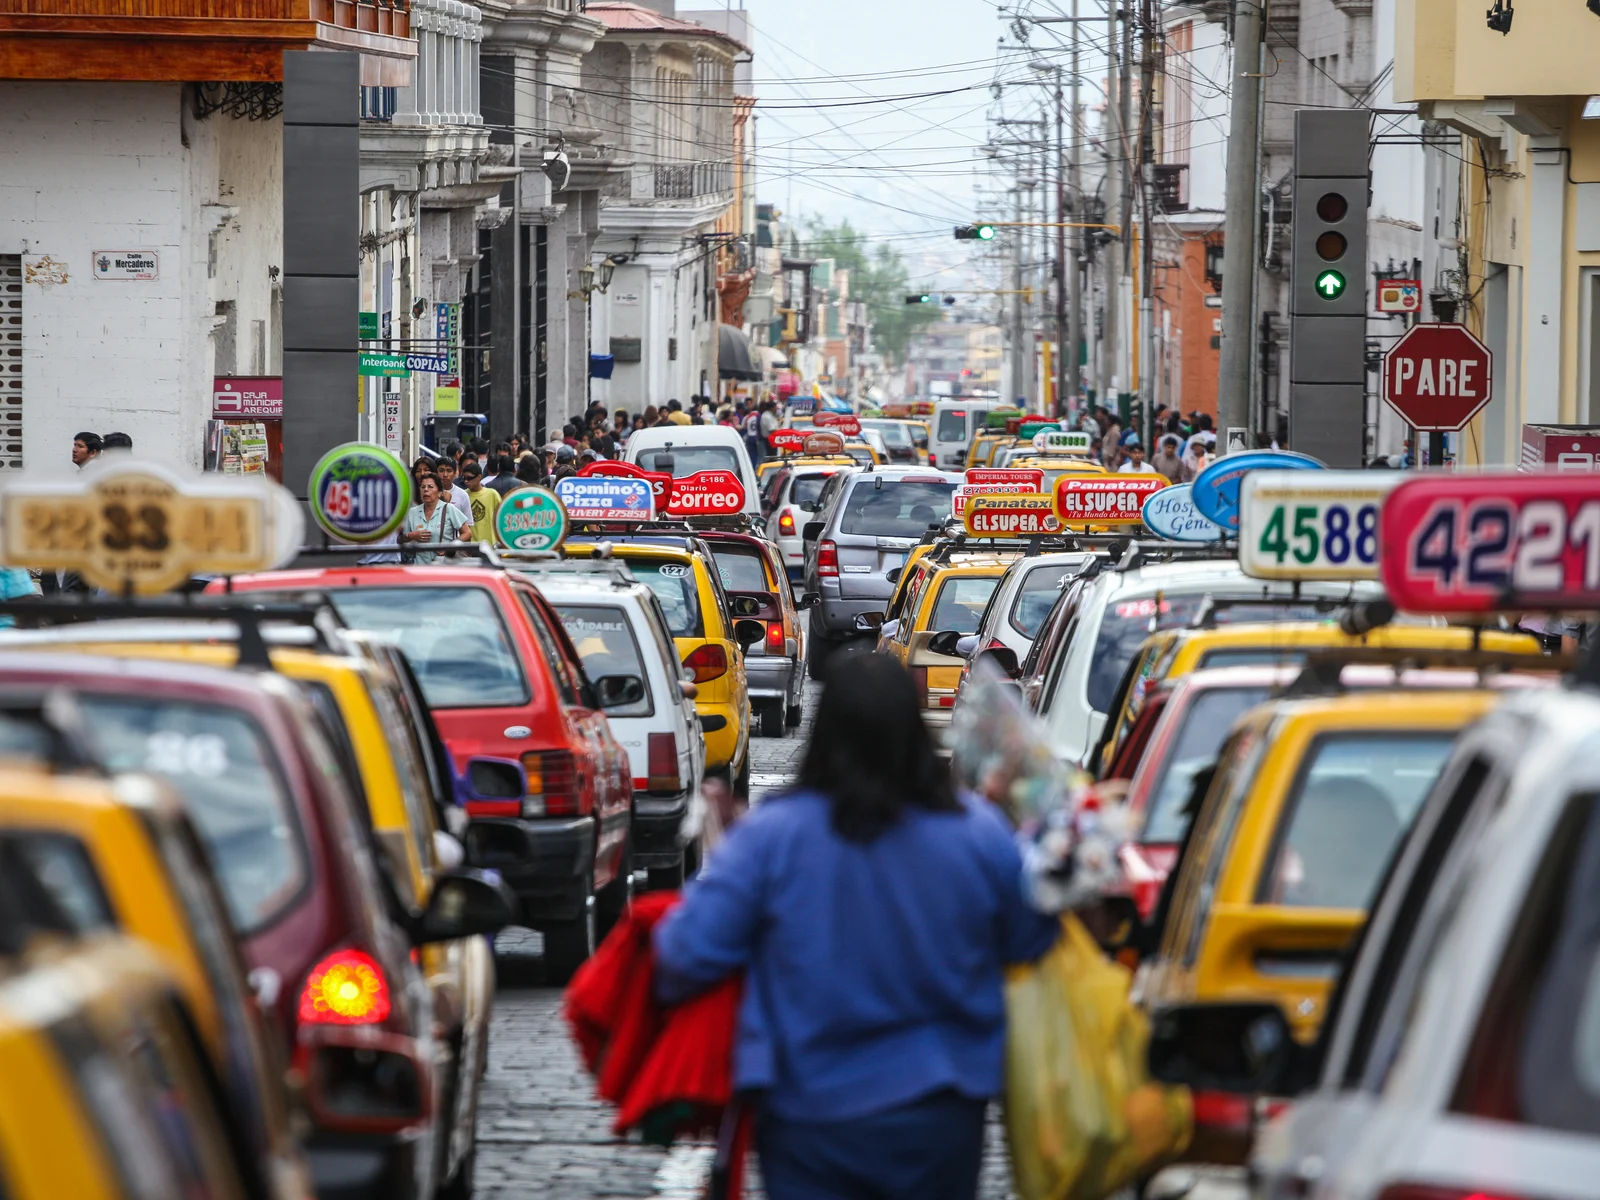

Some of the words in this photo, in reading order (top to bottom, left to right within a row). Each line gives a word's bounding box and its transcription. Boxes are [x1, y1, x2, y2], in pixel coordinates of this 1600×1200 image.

[115, 259, 155, 269] Mercaderes
[362, 357, 405, 368] Interbank
[406, 356, 448, 371] COPIAS
[382, 368, 405, 376] agente
[1395, 357, 1478, 397] PARE
[243, 391, 268, 399] CAJA
[243, 399, 283, 407] MUNICIPA
[561, 481, 647, 495] Domino's
[1067, 481, 1157, 490] Panataxi
[324, 480, 393, 519] 46-1111
[561, 494, 613, 508] Pizza
[668, 490, 739, 508] Correo
[567, 509, 606, 517] ELIVERY
[607, 510, 648, 518] 275858
[1083, 510, 1108, 518] Mundo
[1119, 510, 1142, 519] Comp
[1155, 499, 1196, 518] Hosp
[503, 510, 556, 532] 338419
[1171, 515, 1214, 536] Gene
[564, 620, 622, 632] OLVIDABLE
